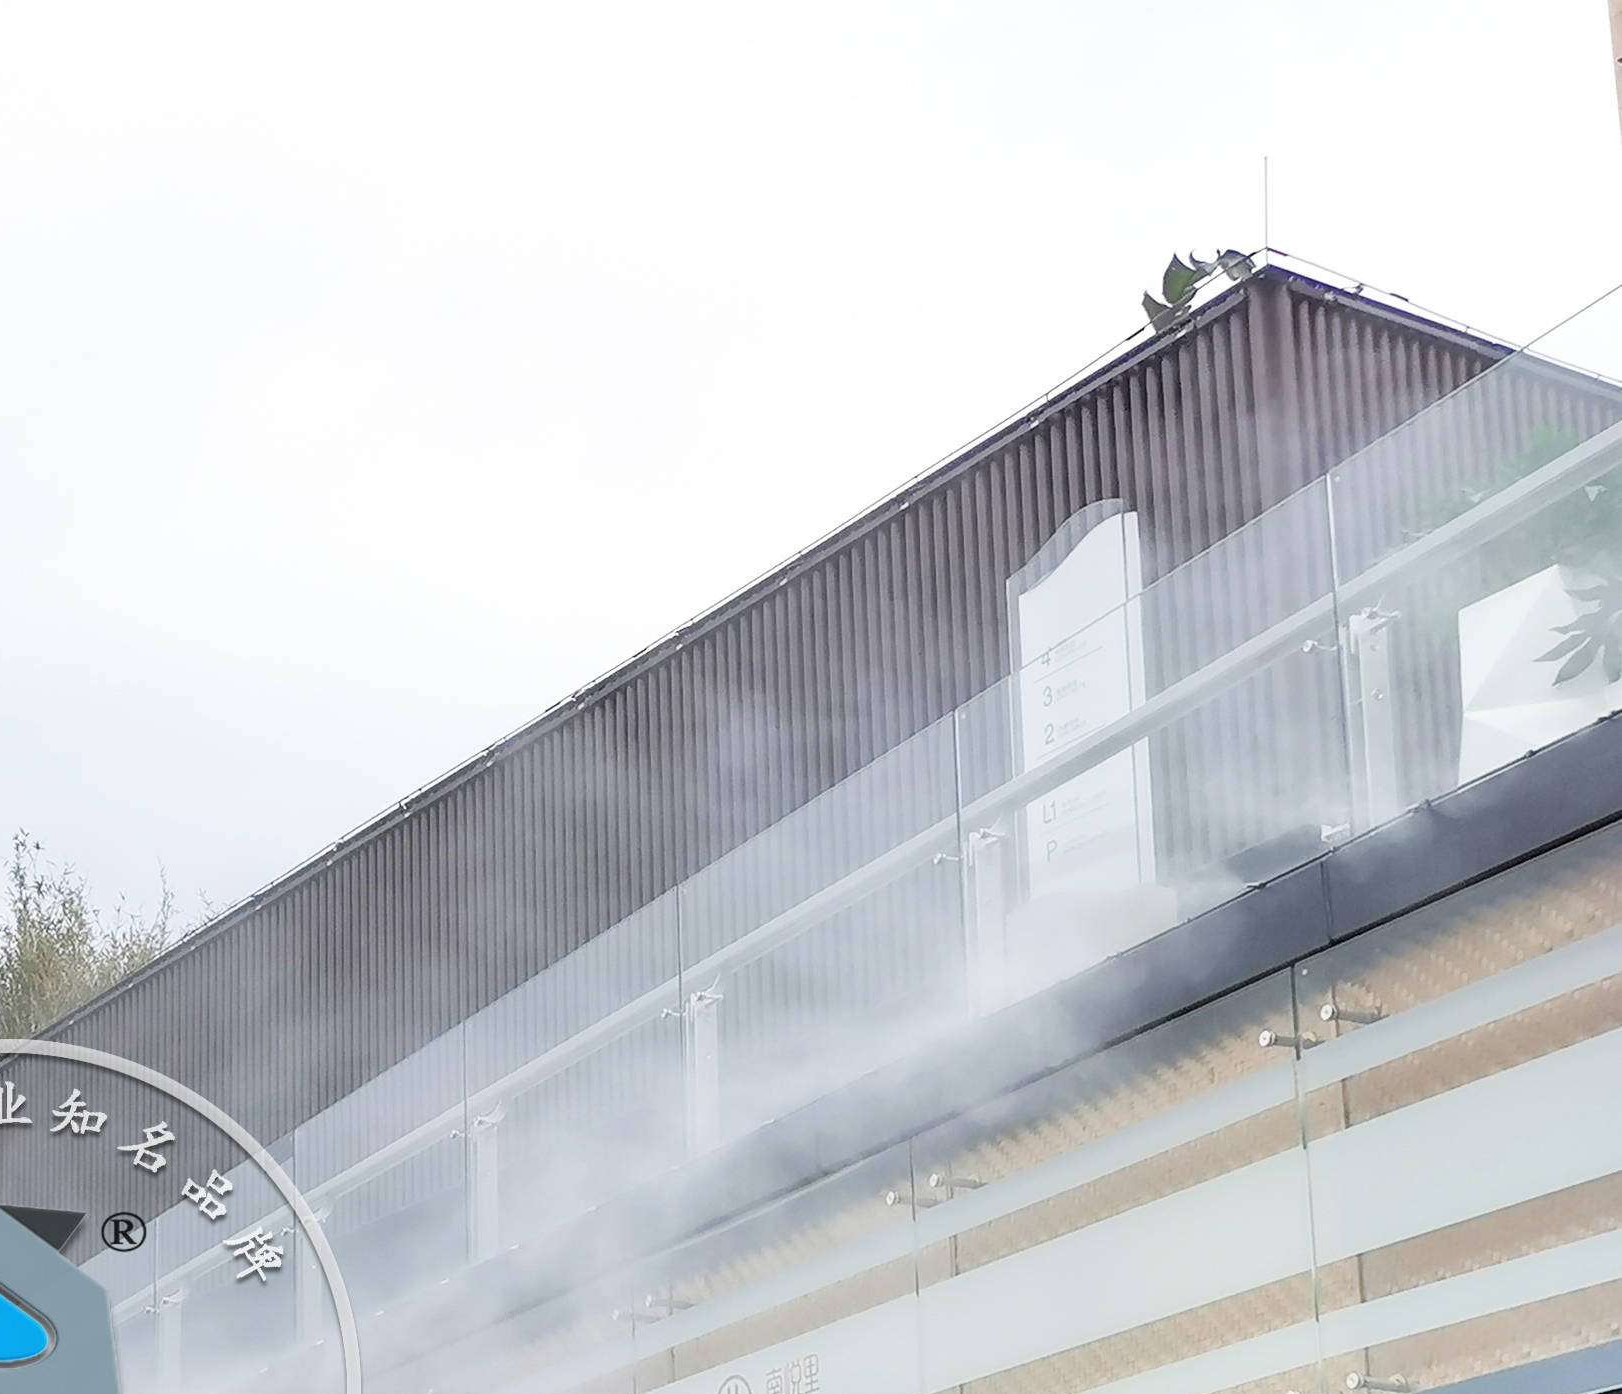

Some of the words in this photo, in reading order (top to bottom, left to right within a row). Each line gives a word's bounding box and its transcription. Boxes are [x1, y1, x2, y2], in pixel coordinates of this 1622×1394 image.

[1042, 685, 1053, 707] 3
[1044, 722, 1055, 744] 2
[1046, 839, 1058, 862] P
